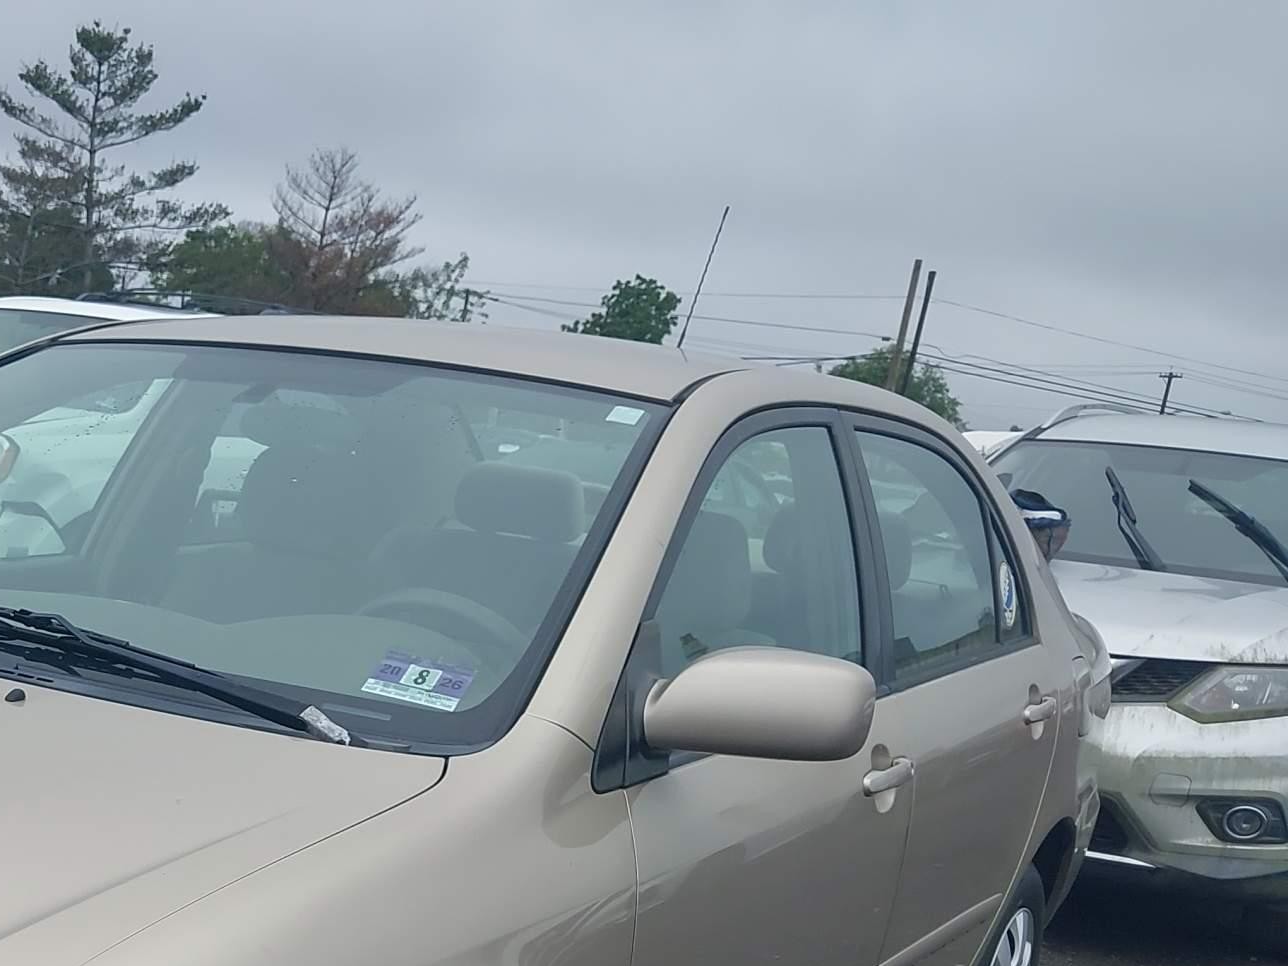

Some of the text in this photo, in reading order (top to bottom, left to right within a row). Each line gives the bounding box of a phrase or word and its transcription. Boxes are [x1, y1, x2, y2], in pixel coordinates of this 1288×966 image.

[379, 663, 465, 690] 20 8 26
